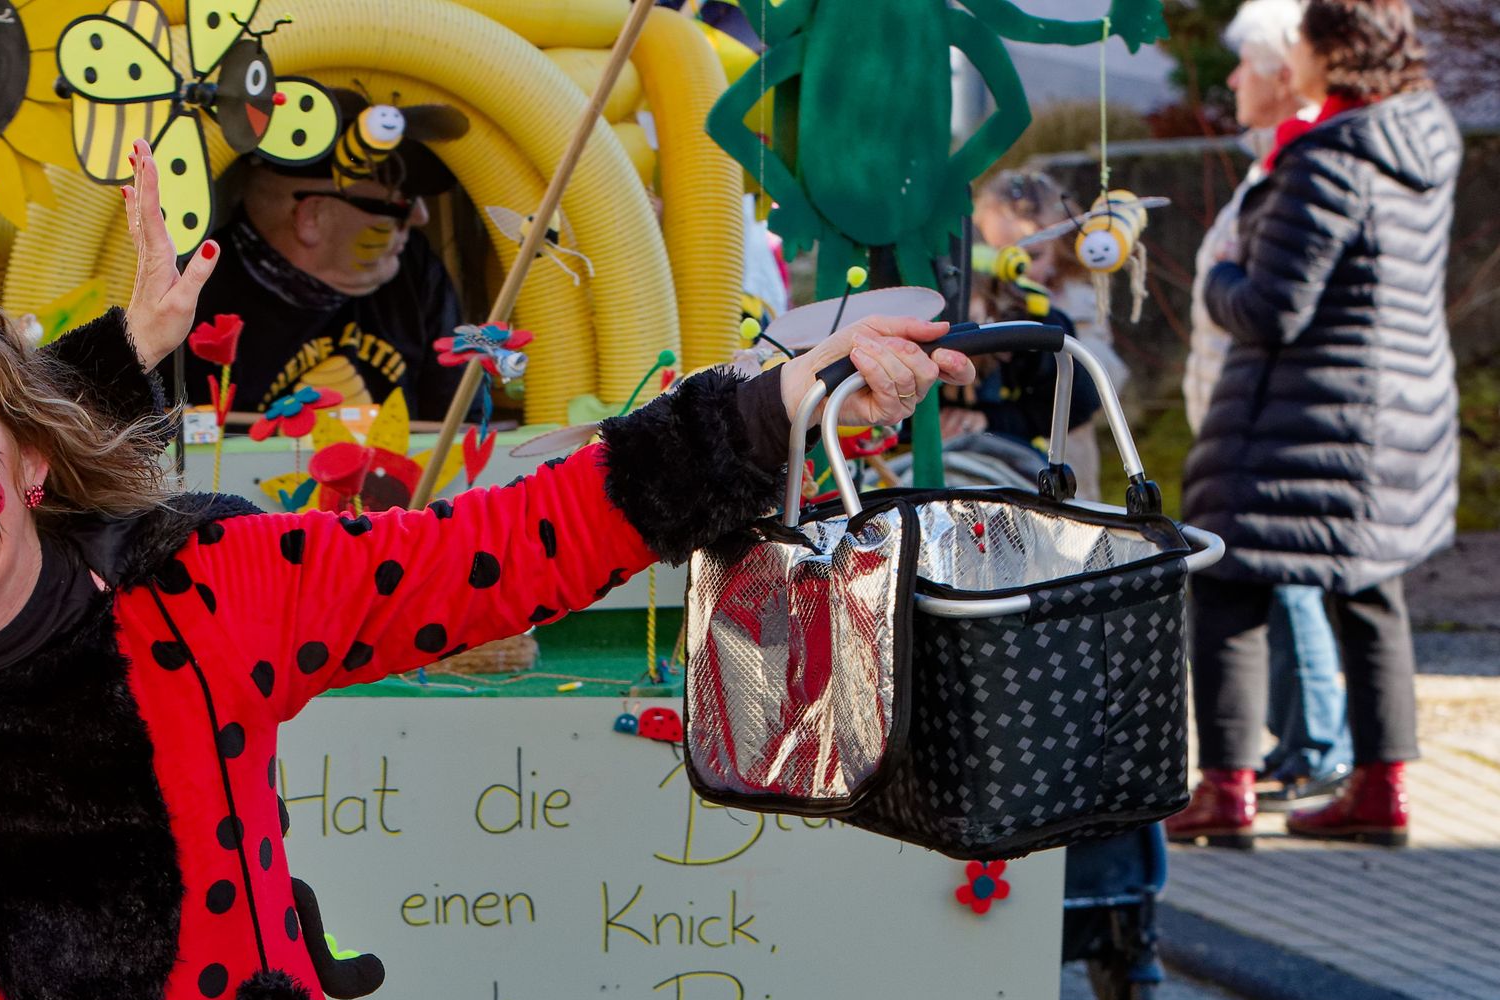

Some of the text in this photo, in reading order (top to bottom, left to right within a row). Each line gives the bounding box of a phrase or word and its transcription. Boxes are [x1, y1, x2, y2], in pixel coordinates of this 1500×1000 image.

[278, 754, 403, 838] Hat
[475, 746, 572, 835] die
[401, 881, 780, 955] einen Knick,
